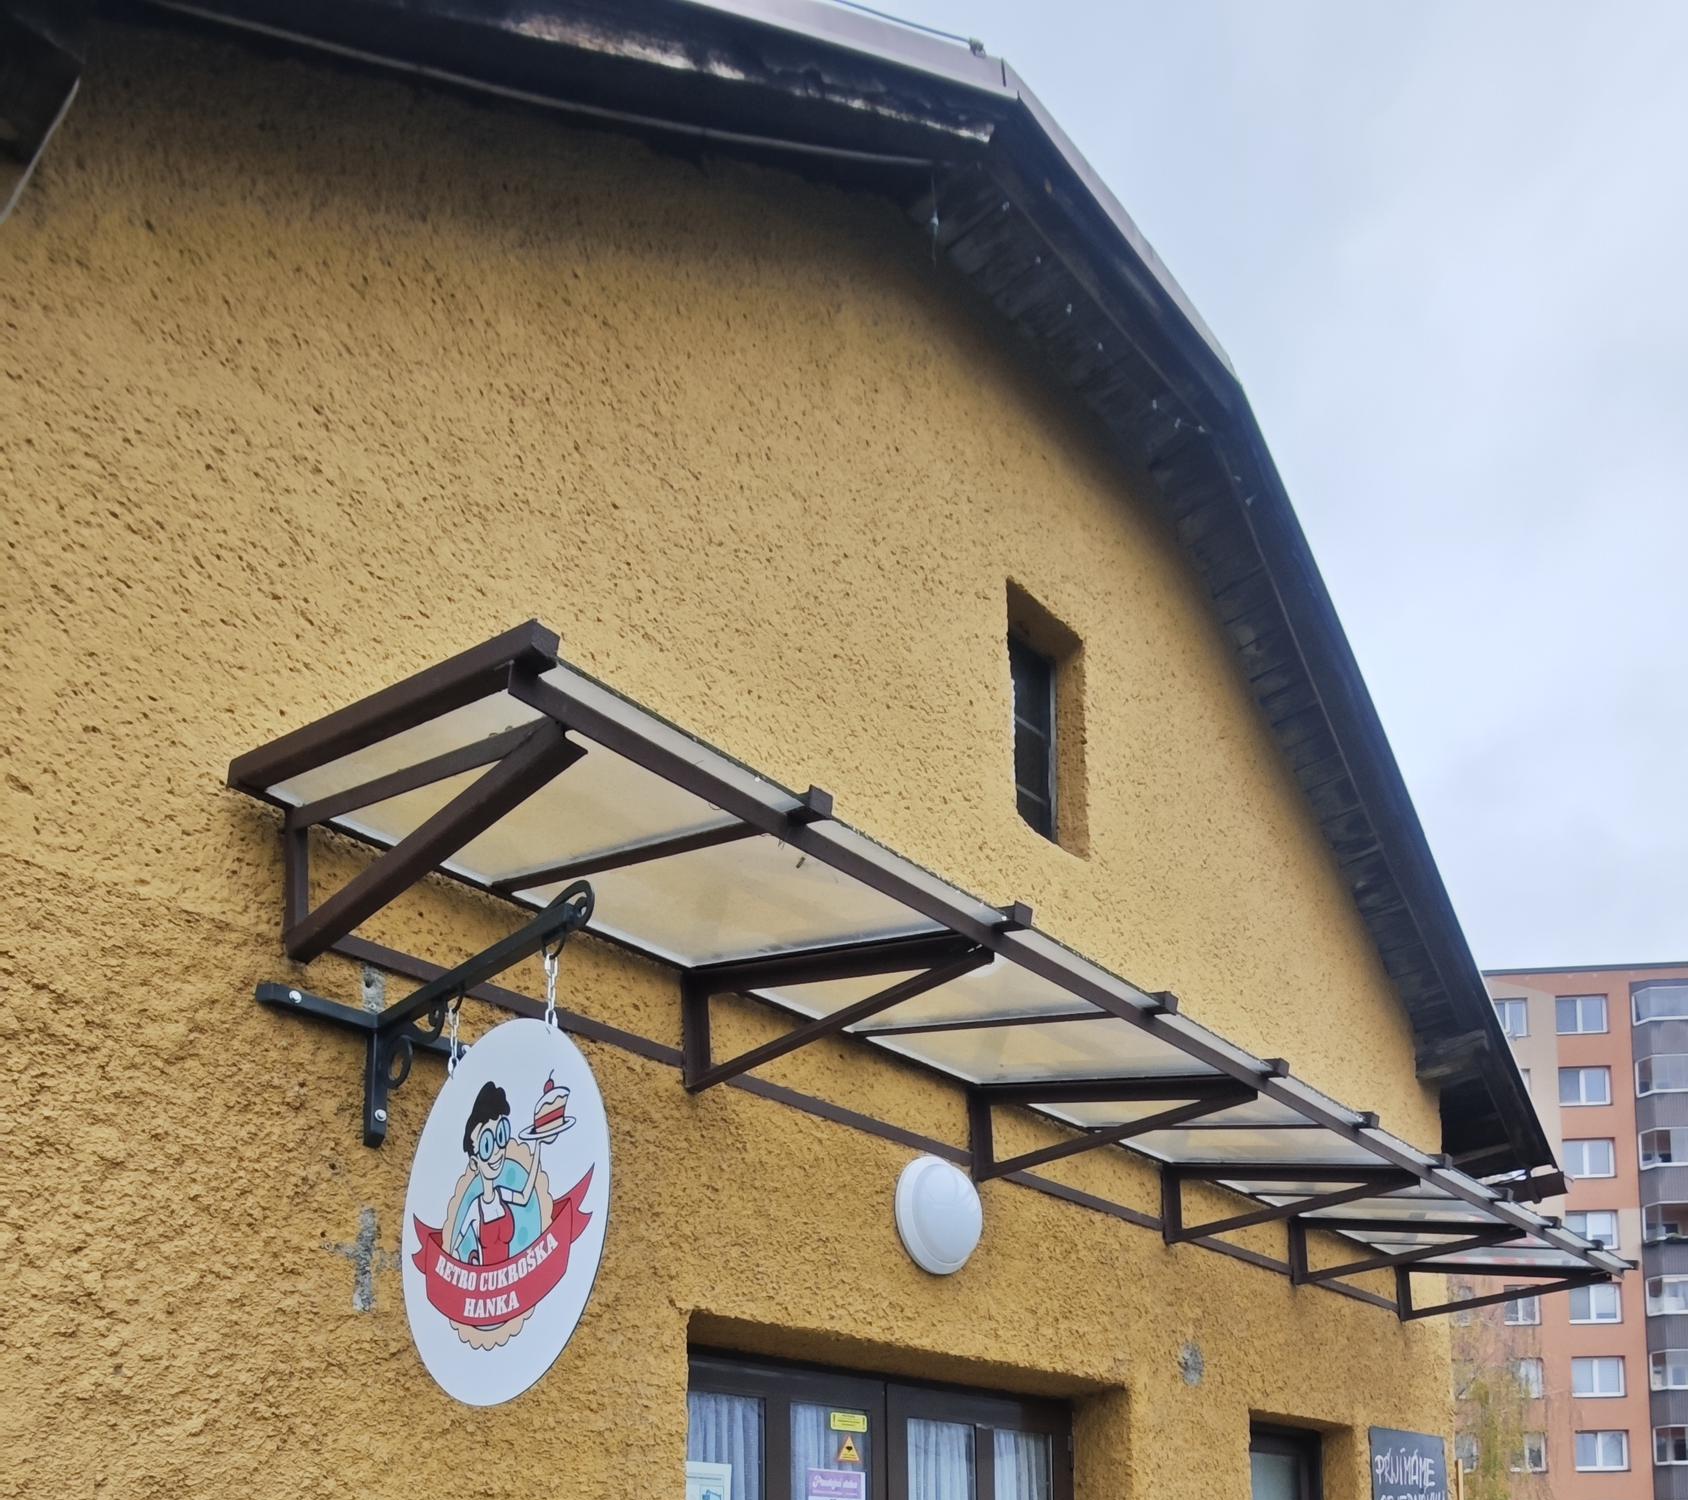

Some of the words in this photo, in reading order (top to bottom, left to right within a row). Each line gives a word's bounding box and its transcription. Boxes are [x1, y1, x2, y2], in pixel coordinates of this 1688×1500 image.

[435, 1254, 477, 1292] RETRO
[479, 1232, 559, 1292] CUKROŠKA
[463, 1290, 520, 1319] HANKA
